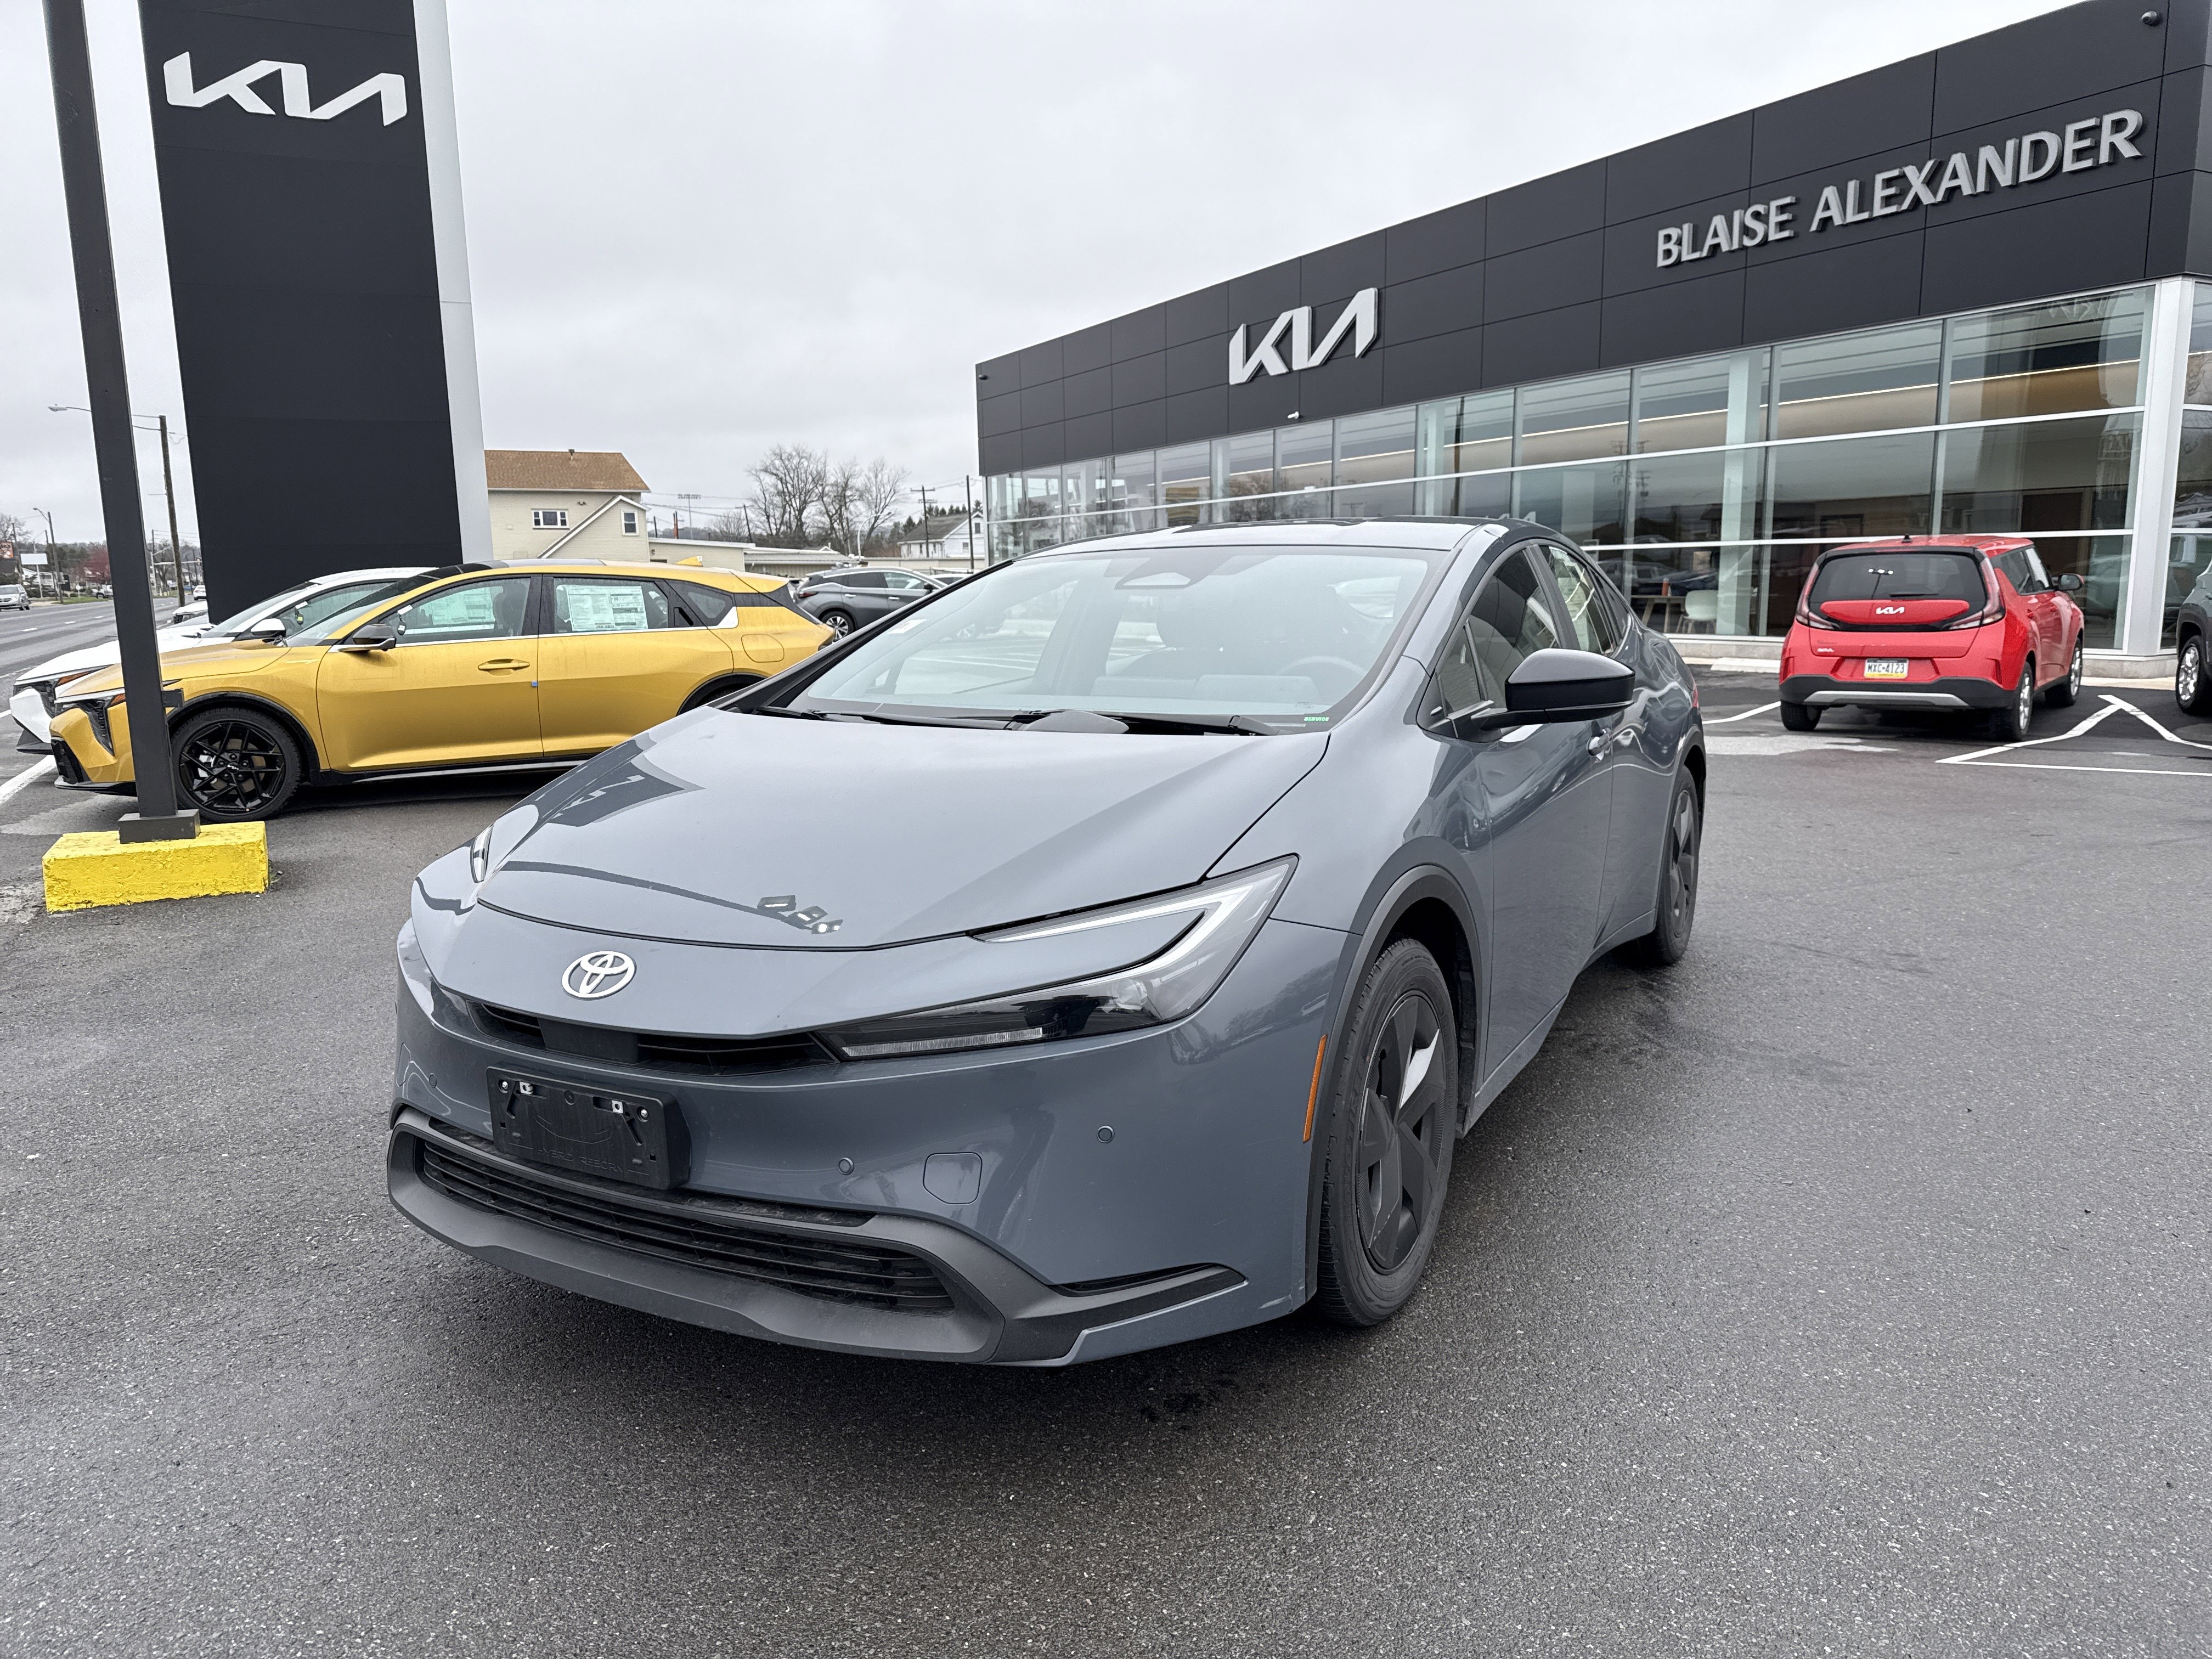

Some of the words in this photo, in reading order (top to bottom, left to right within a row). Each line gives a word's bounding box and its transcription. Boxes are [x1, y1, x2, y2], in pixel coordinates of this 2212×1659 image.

[163, 52, 407, 126] KIA
[1656, 195, 1796, 268] BLAISE
[1810, 109, 2144, 232] ALEXANDER
[1229, 287, 1378, 385] KIA
[1876, 606, 1905, 614] KIA
